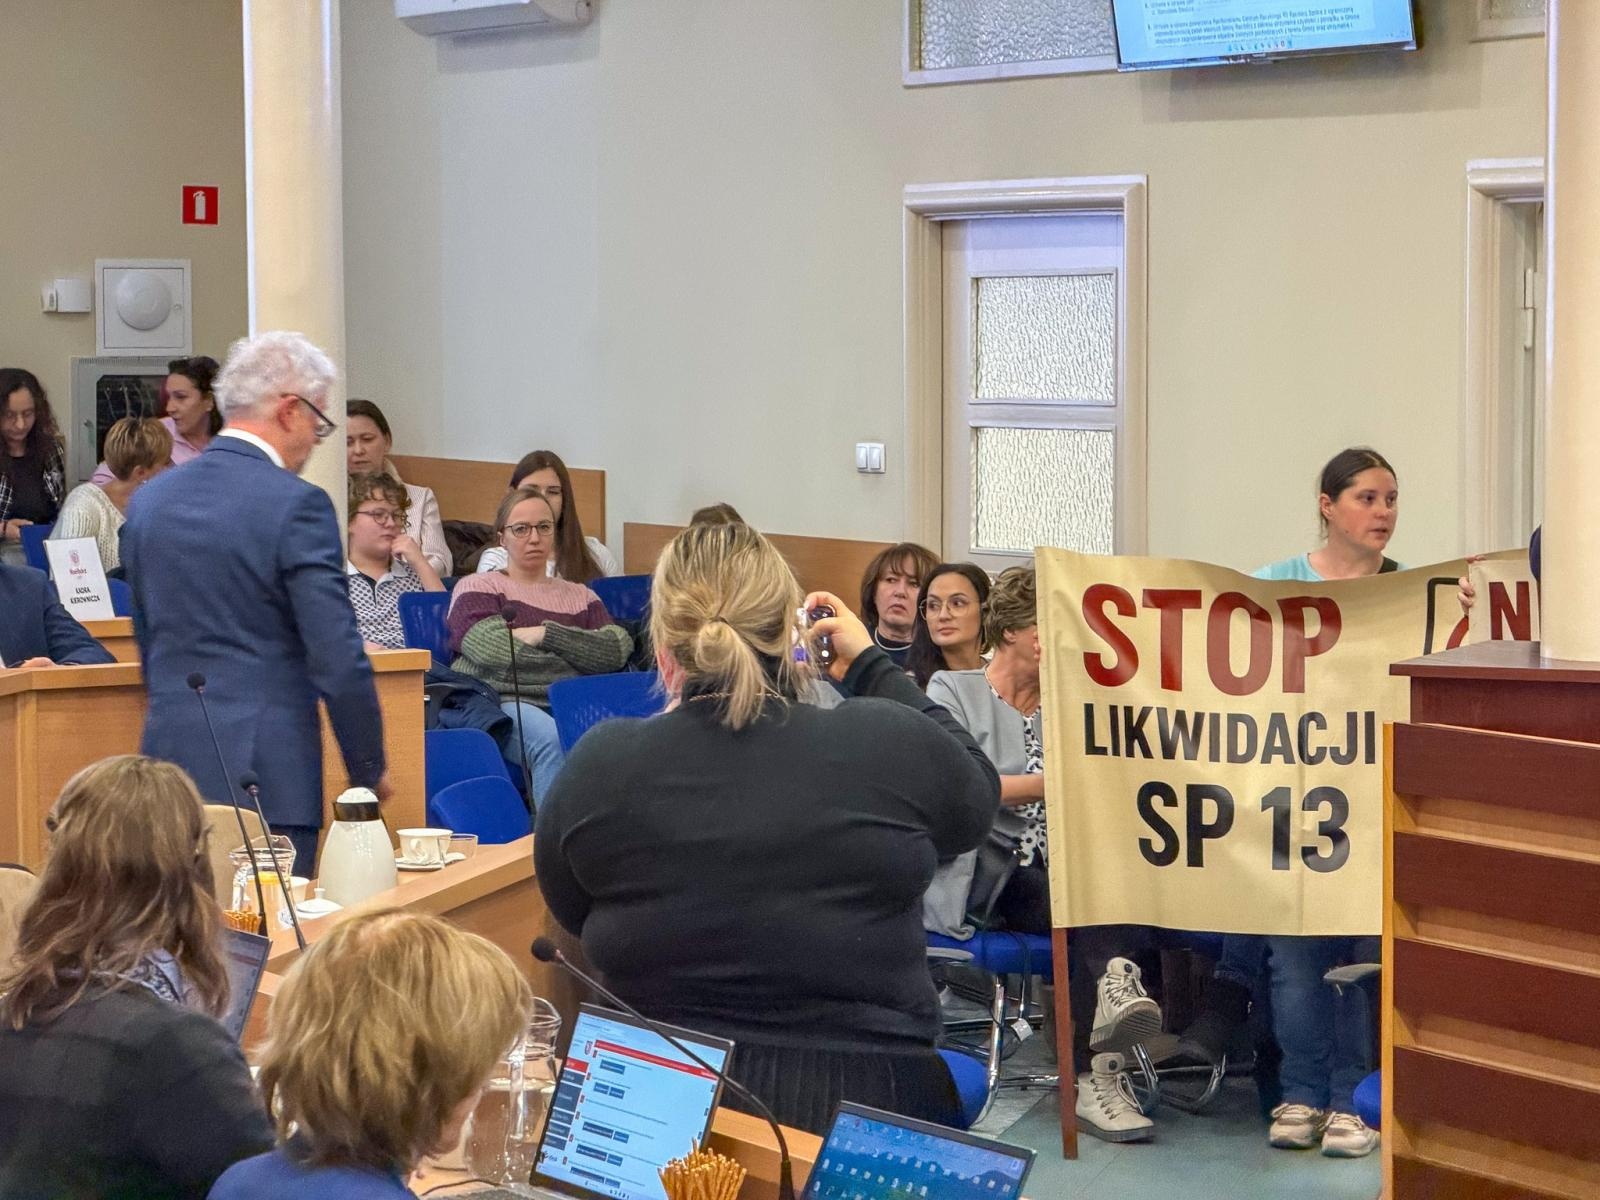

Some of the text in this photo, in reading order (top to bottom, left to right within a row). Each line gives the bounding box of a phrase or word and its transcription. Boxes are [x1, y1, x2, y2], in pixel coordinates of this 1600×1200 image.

[1082, 583, 1342, 696] STOP
[1488, 580, 1532, 642] N
[1083, 702, 1377, 766] LIKWIDACJI
[1136, 780, 1351, 873] SP 13
